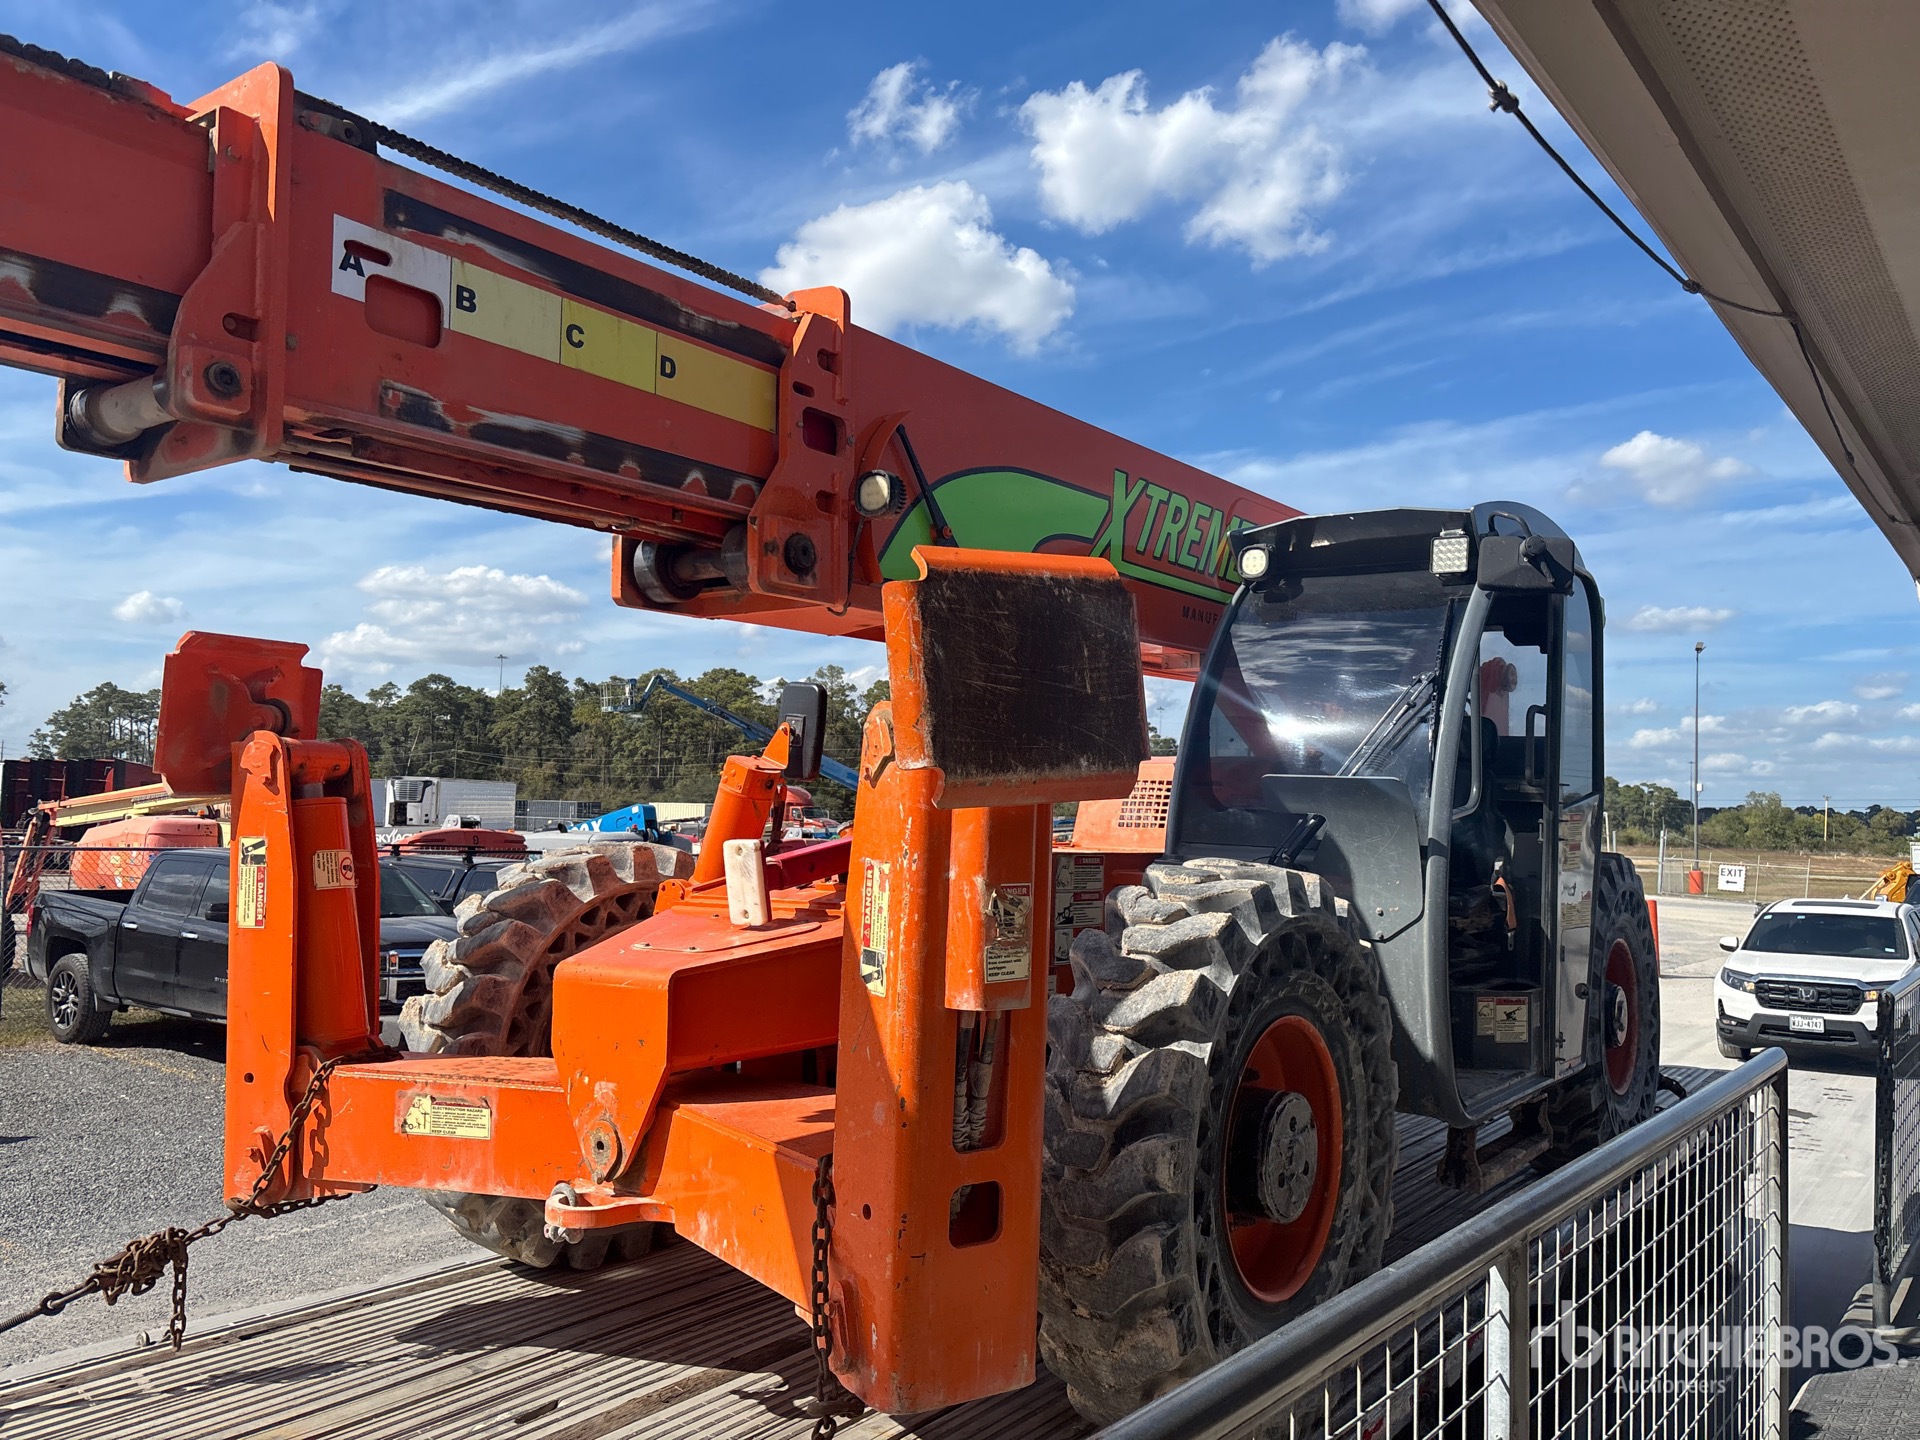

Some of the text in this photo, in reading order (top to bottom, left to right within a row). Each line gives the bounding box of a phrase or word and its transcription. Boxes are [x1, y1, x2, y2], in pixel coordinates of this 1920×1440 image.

[339, 251, 366, 278] A
[456, 285, 477, 313] B
[566, 324, 585, 348] C
[660, 355, 677, 379] D
[1720, 867, 1743, 878] EXIT
[865, 869, 873, 924] DANGER
